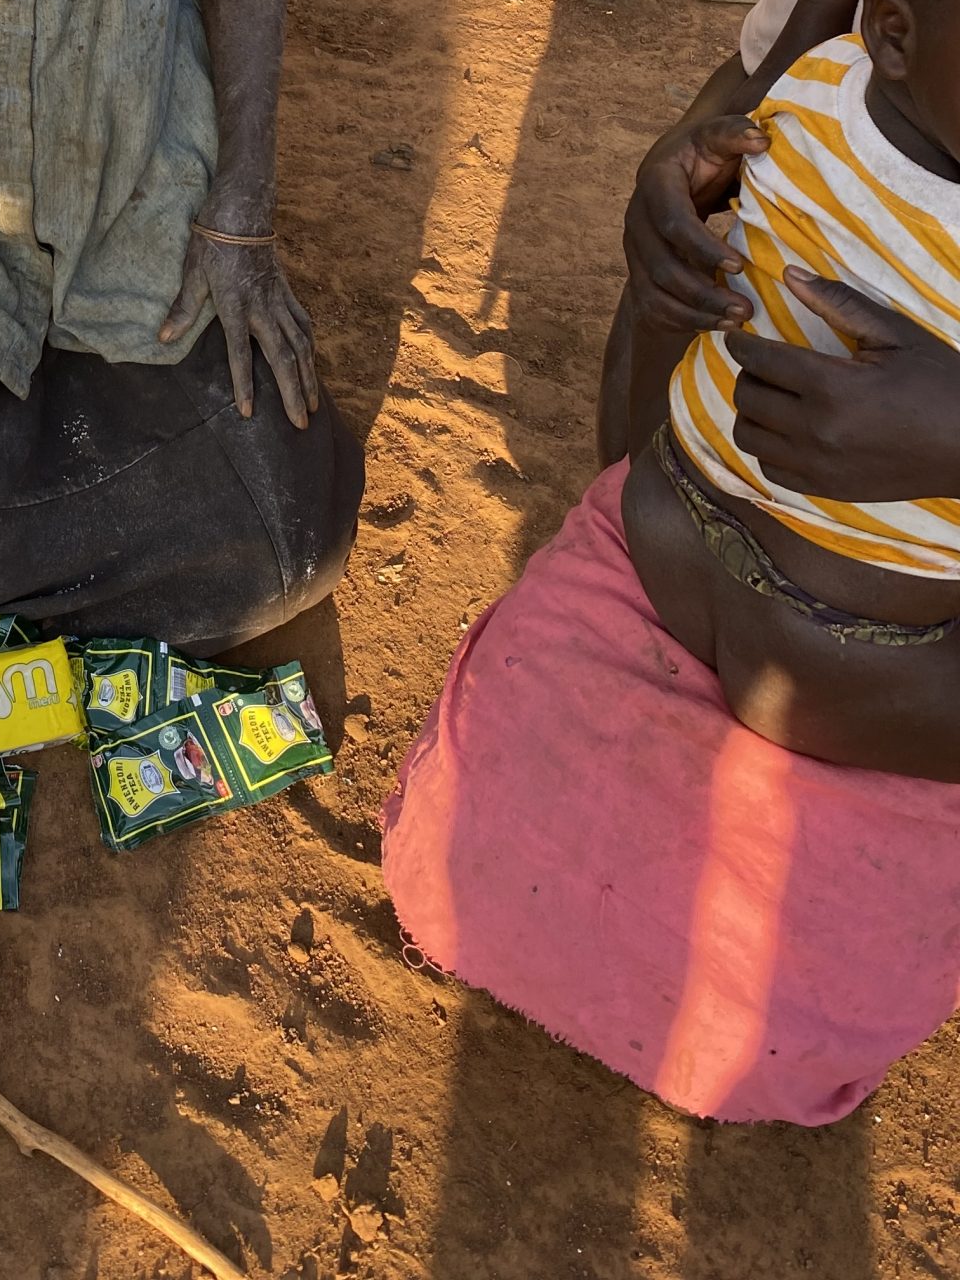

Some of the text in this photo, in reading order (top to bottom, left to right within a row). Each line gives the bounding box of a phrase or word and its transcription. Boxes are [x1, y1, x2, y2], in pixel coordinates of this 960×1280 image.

[120, 673, 131, 717] RWENZORI
[248, 710, 274, 758] RWENZORI
[259, 721, 272, 743] TEA
[115, 761, 140, 811] RWENZORI
[126, 773, 138, 795] TEA
